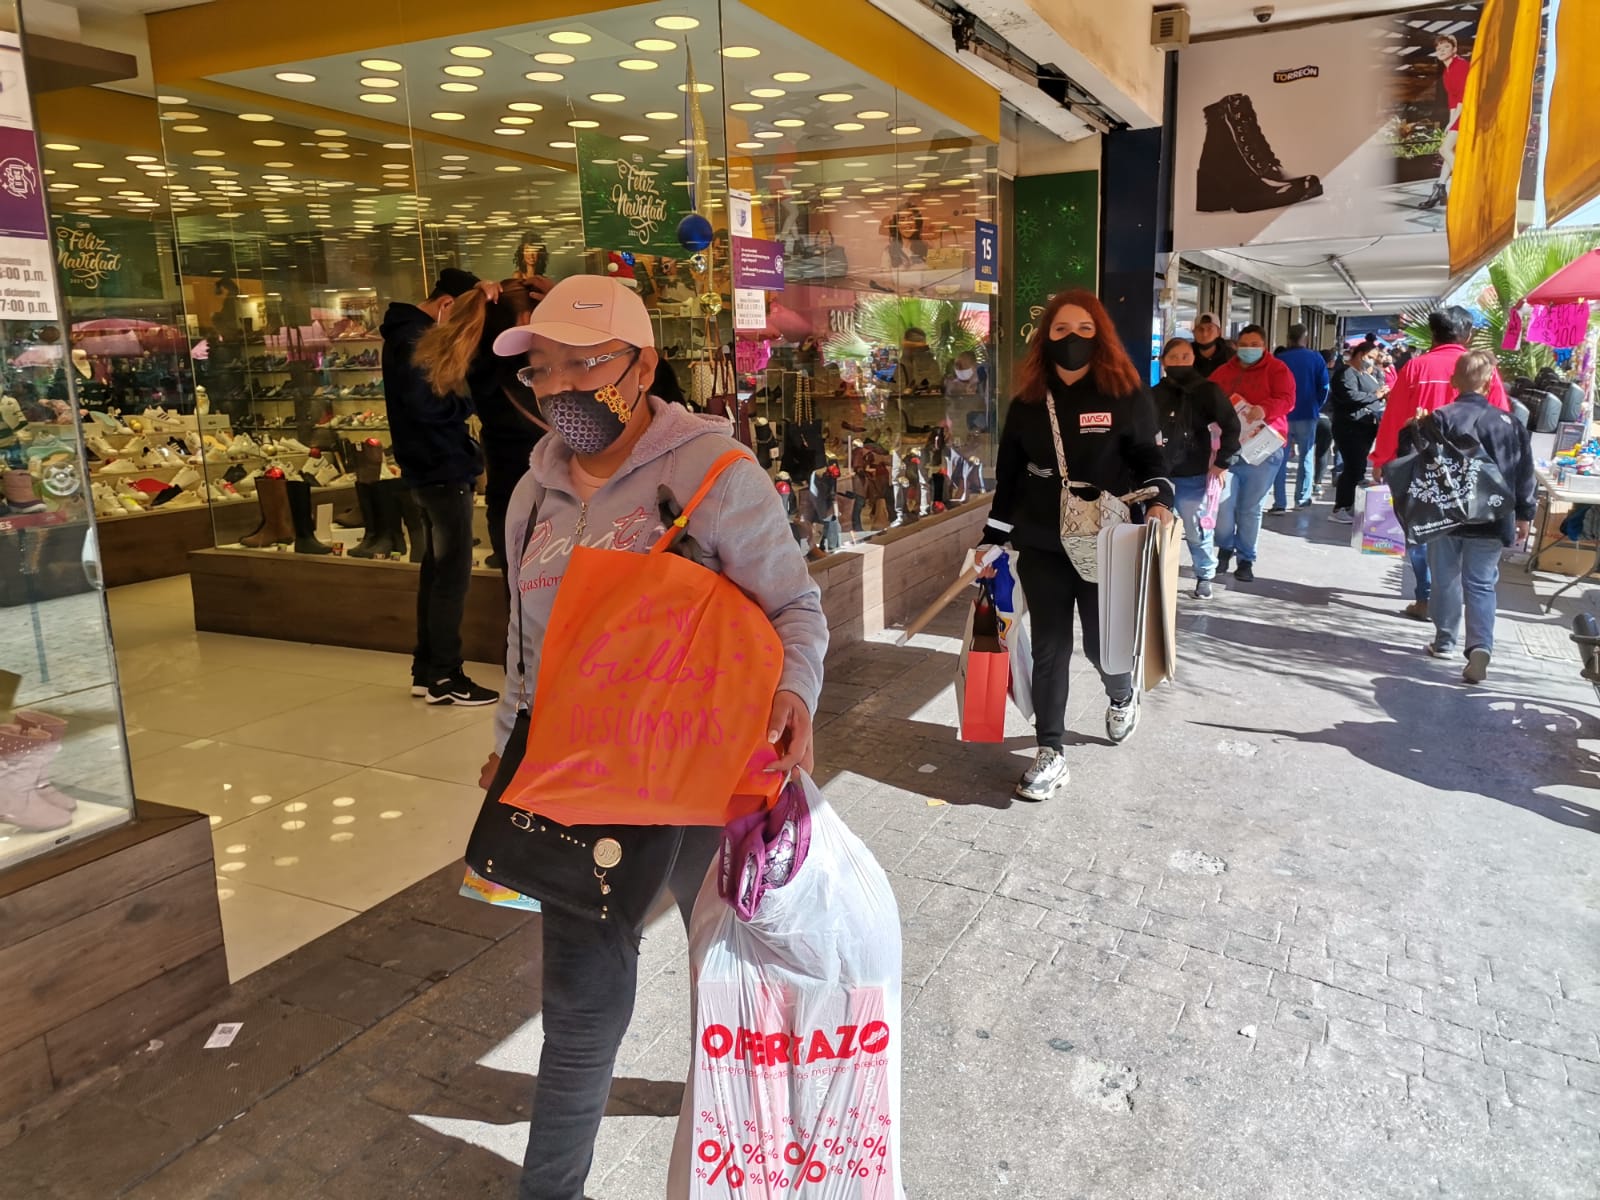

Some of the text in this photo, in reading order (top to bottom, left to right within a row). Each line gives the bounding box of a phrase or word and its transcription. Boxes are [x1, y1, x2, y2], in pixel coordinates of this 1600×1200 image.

[617, 158, 659, 195] Feliz
[612, 184, 667, 234] Navidad
[56, 226, 111, 251] Feliz
[982, 238, 992, 260] 15
[24, 270, 48, 282] p.m.
[58, 245, 122, 282] Navidad
[28, 302, 52, 314] p.m.
[1082, 415, 1109, 424] NASA
[701, 1020, 890, 1067] OFERTAZO
